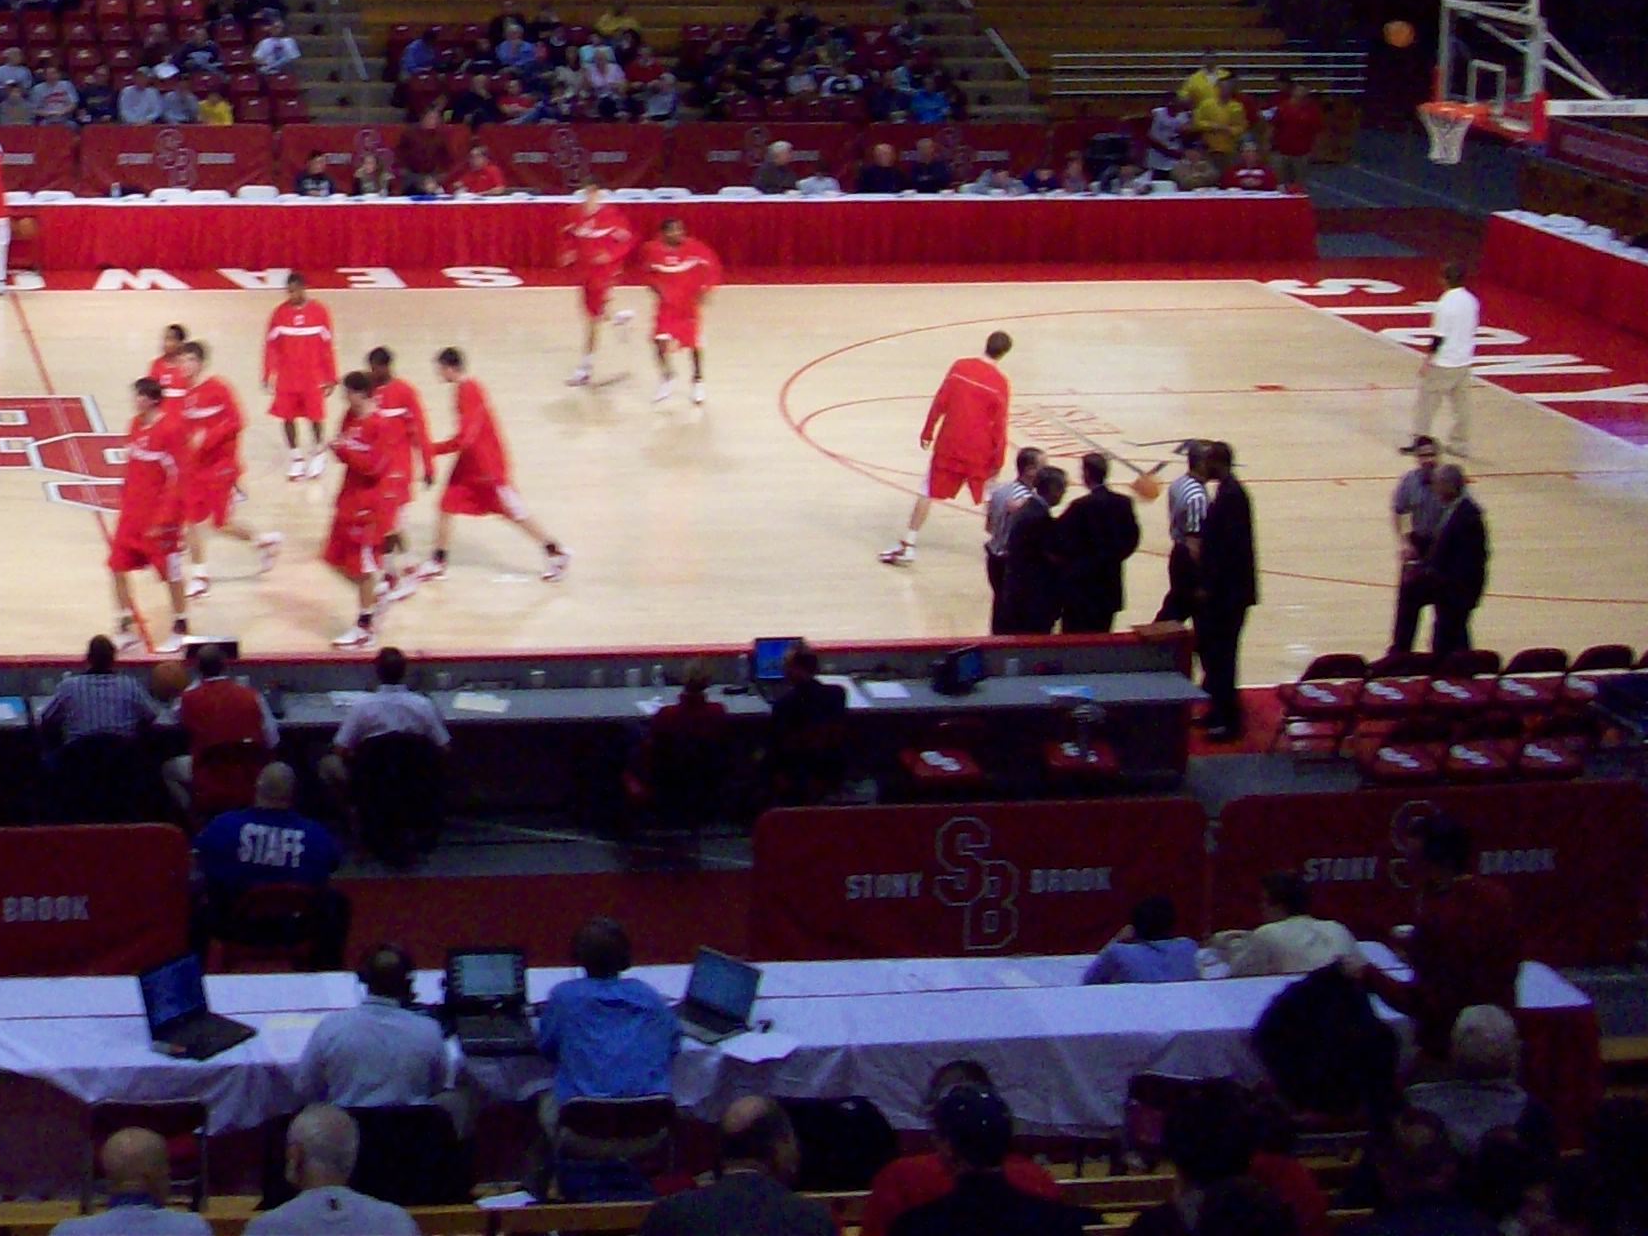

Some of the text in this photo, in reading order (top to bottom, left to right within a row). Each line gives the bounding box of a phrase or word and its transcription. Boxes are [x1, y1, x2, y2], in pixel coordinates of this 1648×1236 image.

[239, 822, 306, 868] STAFF
[844, 871, 924, 901] STONY
[2, 896, 90, 924] BROOK
